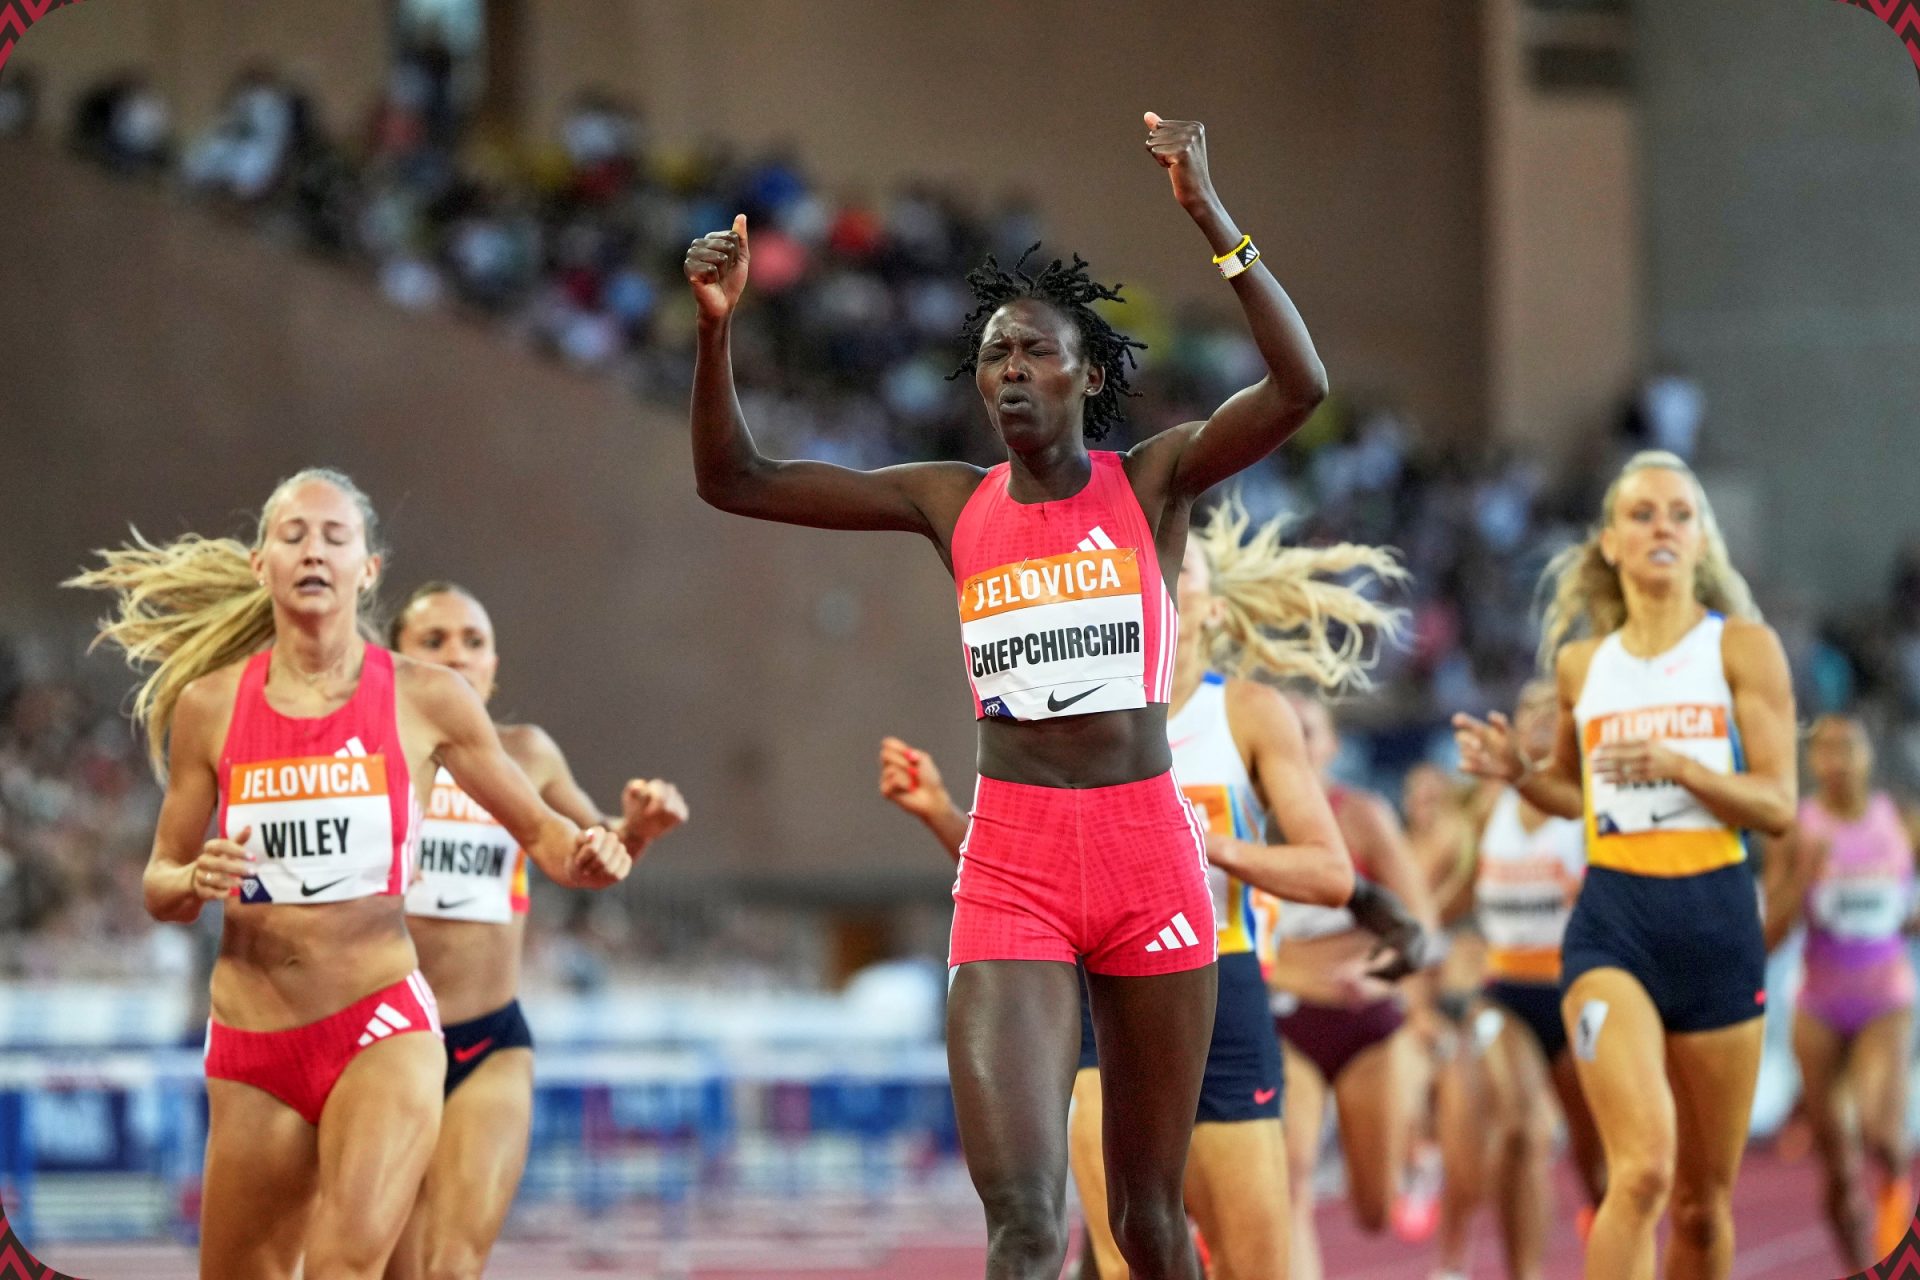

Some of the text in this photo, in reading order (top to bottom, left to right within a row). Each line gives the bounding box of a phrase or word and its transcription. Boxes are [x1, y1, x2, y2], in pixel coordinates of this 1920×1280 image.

[973, 558, 1121, 612] JELOVICA
[971, 621, 1140, 678] CHEPCHIRCHIR
[240, 762, 370, 799] JELOVICA
[261, 817, 350, 858] WILEY
[420, 838, 507, 878] HNSON
